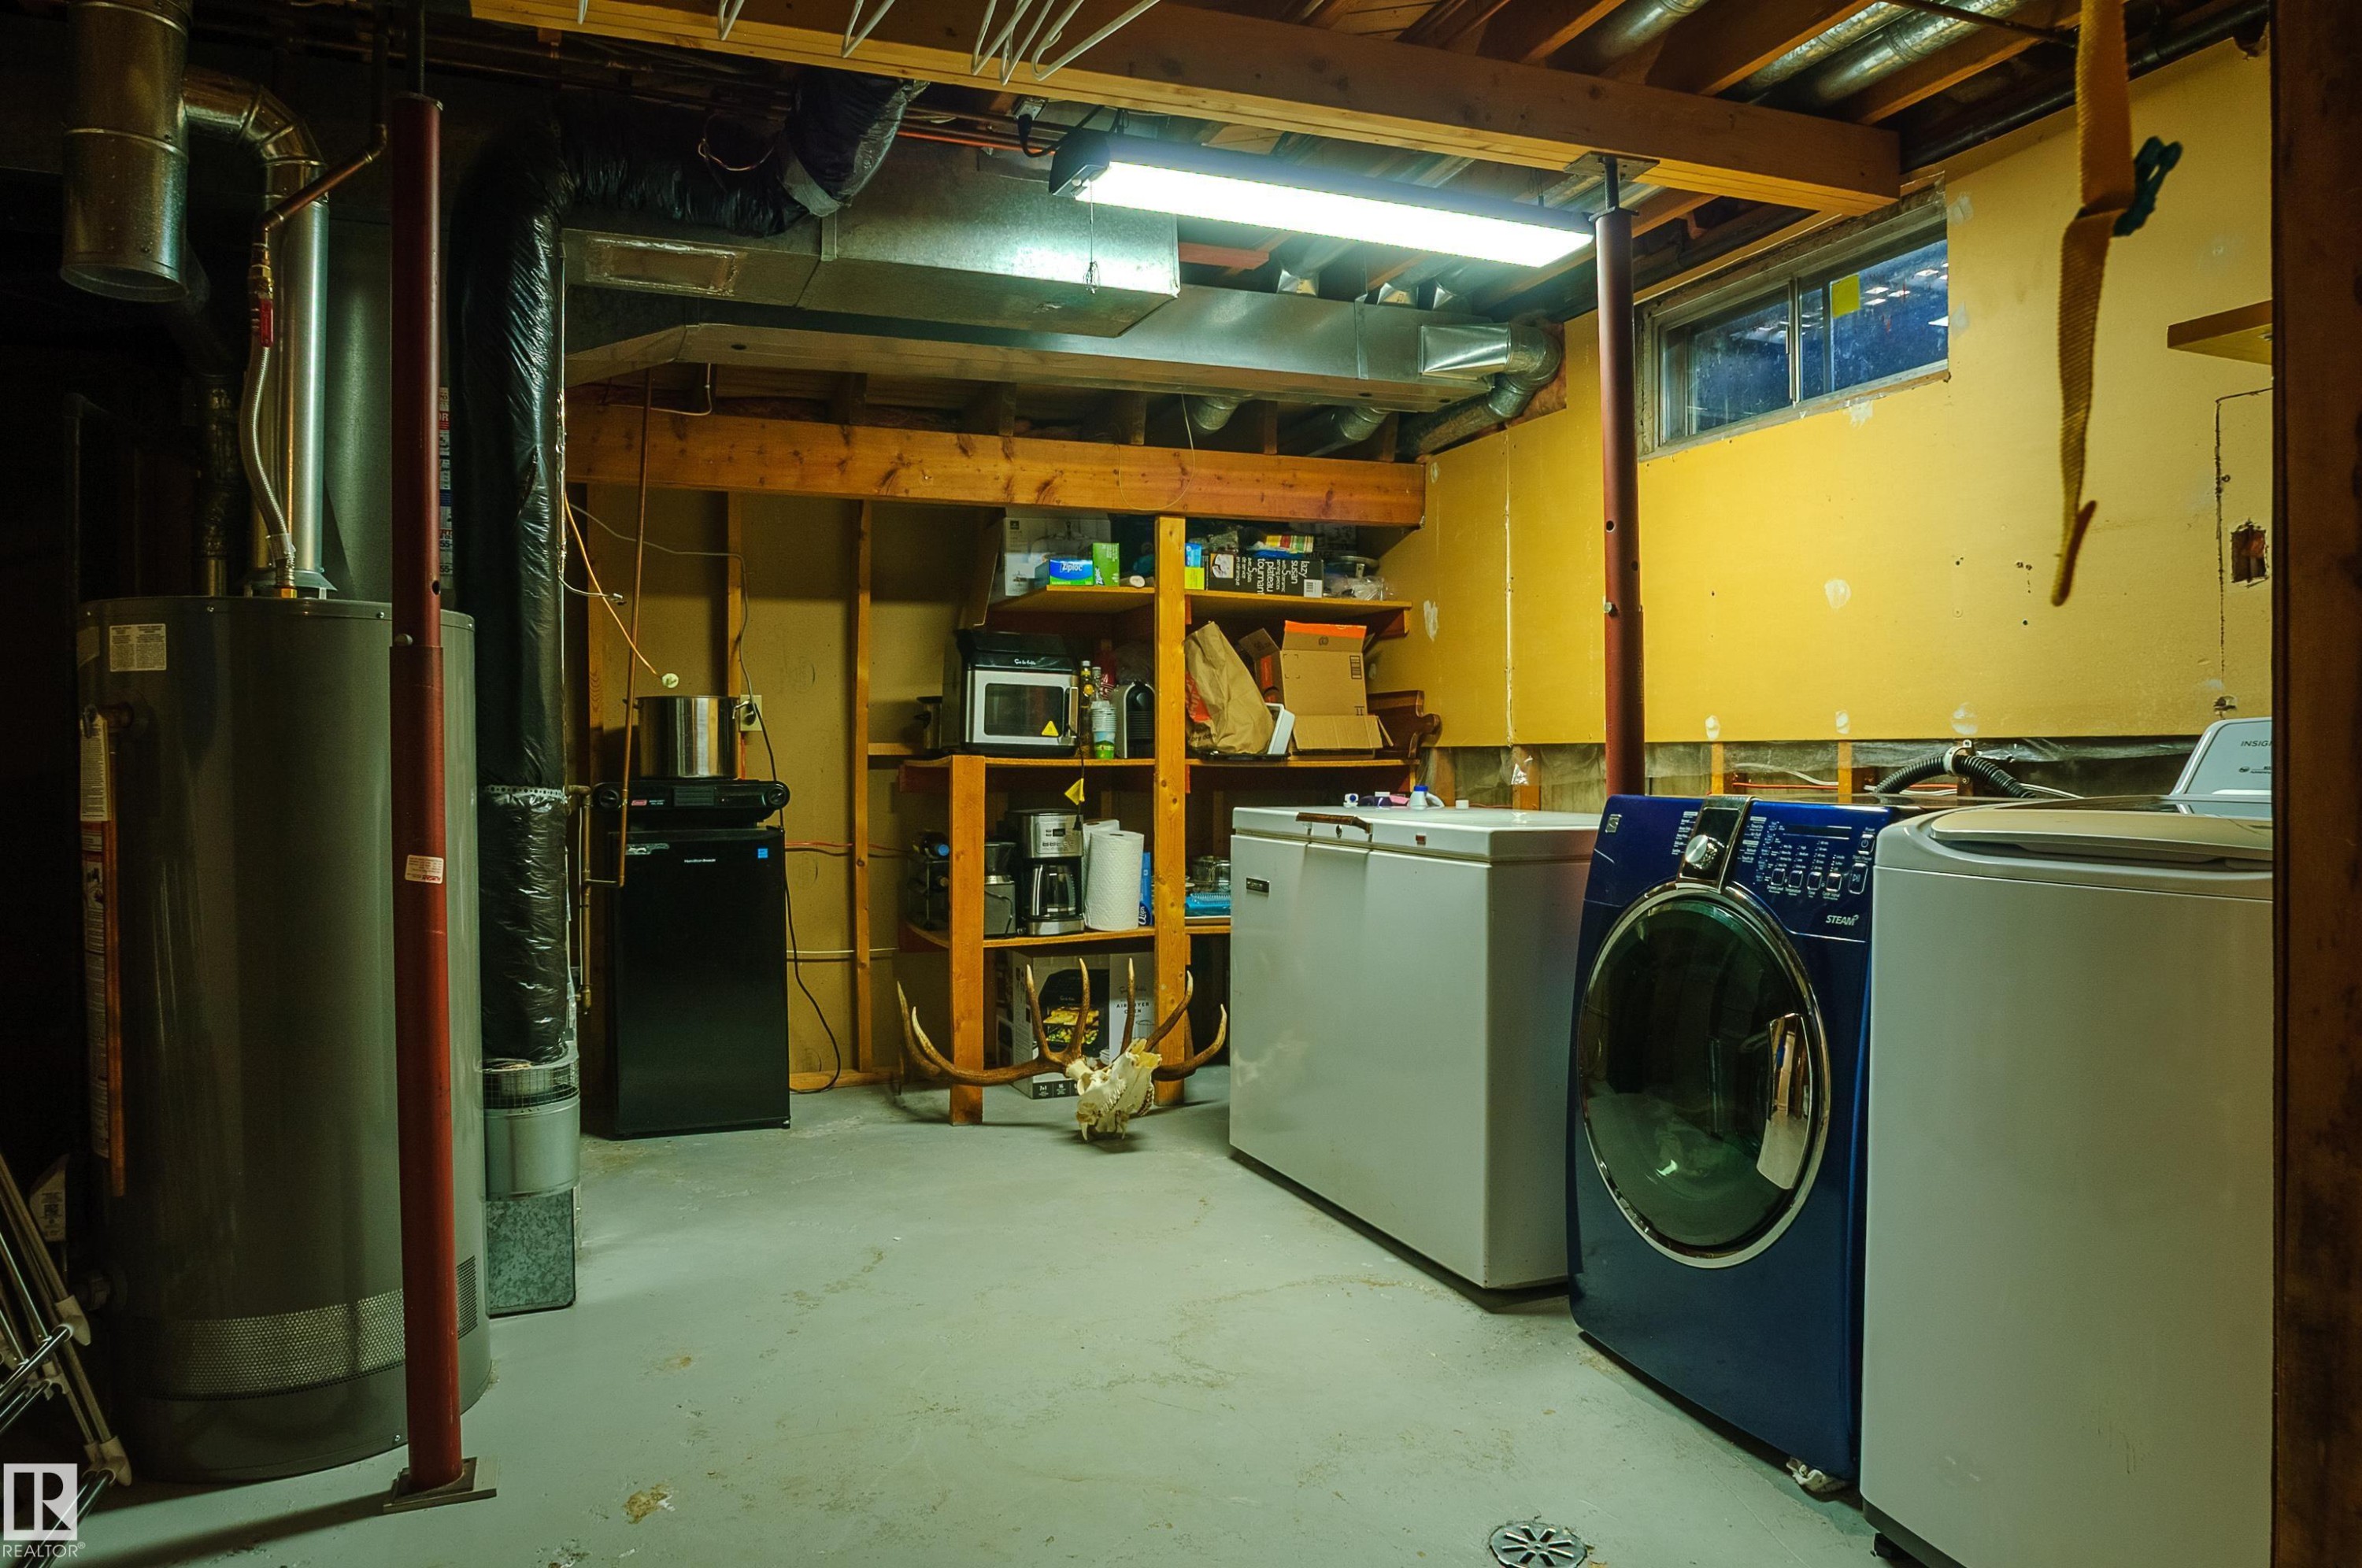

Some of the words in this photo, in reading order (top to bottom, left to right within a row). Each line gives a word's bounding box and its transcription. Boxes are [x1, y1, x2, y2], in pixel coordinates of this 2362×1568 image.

[1061, 563, 1083, 573] Ziploc
[1094, 567, 1104, 585] Ziploc
[1264, 561, 1275, 592] plateau
[1298, 560, 1310, 579] lazy
[1825, 915, 1855, 926] STEAM
